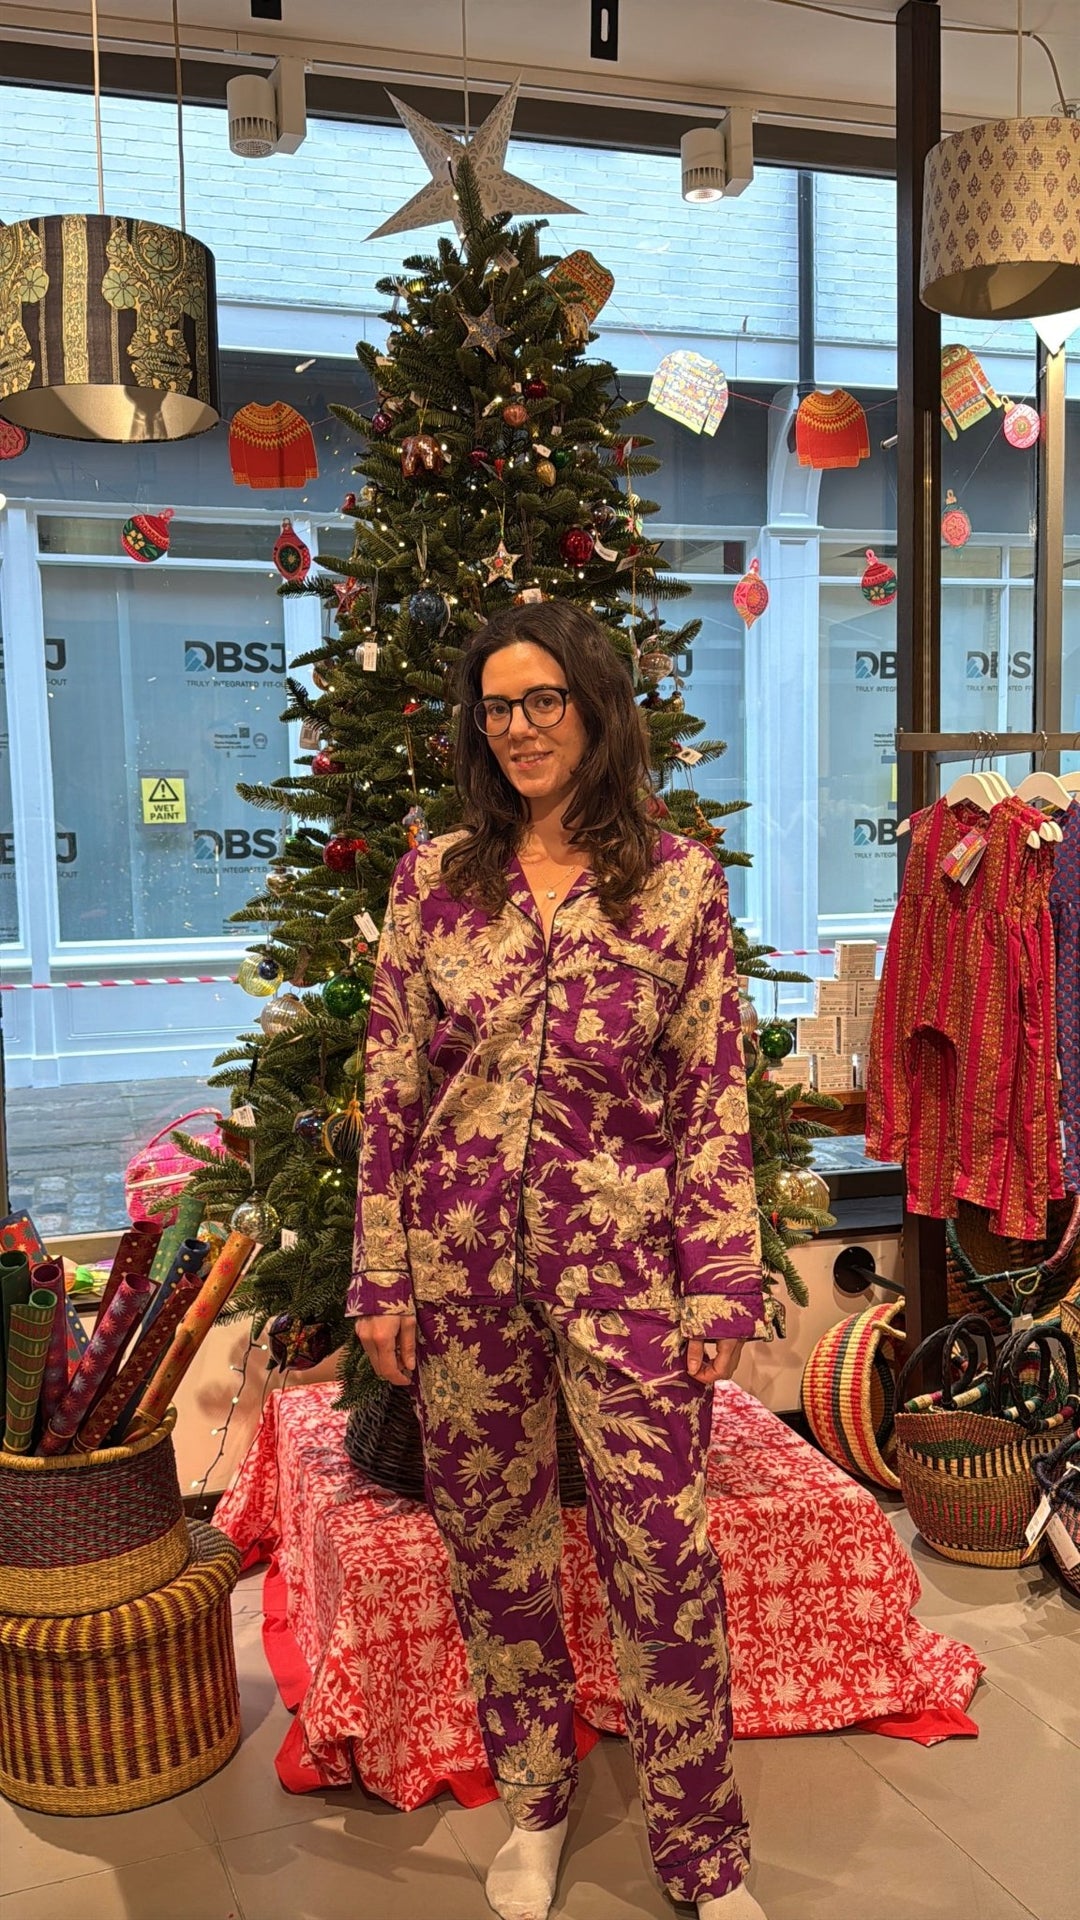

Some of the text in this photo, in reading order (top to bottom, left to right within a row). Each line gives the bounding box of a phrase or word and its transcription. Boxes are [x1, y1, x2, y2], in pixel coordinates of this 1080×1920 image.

[855, 651, 897, 679] DB
[213, 680, 259, 688] INTEGRATED
[153, 804, 175, 812] WET
[150, 812, 180, 820] PAINT
[853, 818, 897, 846] DB
[193, 829, 279, 860] DBS
[195, 865, 217, 874] TRULY
[222, 865, 268, 873] INTEGRATED
